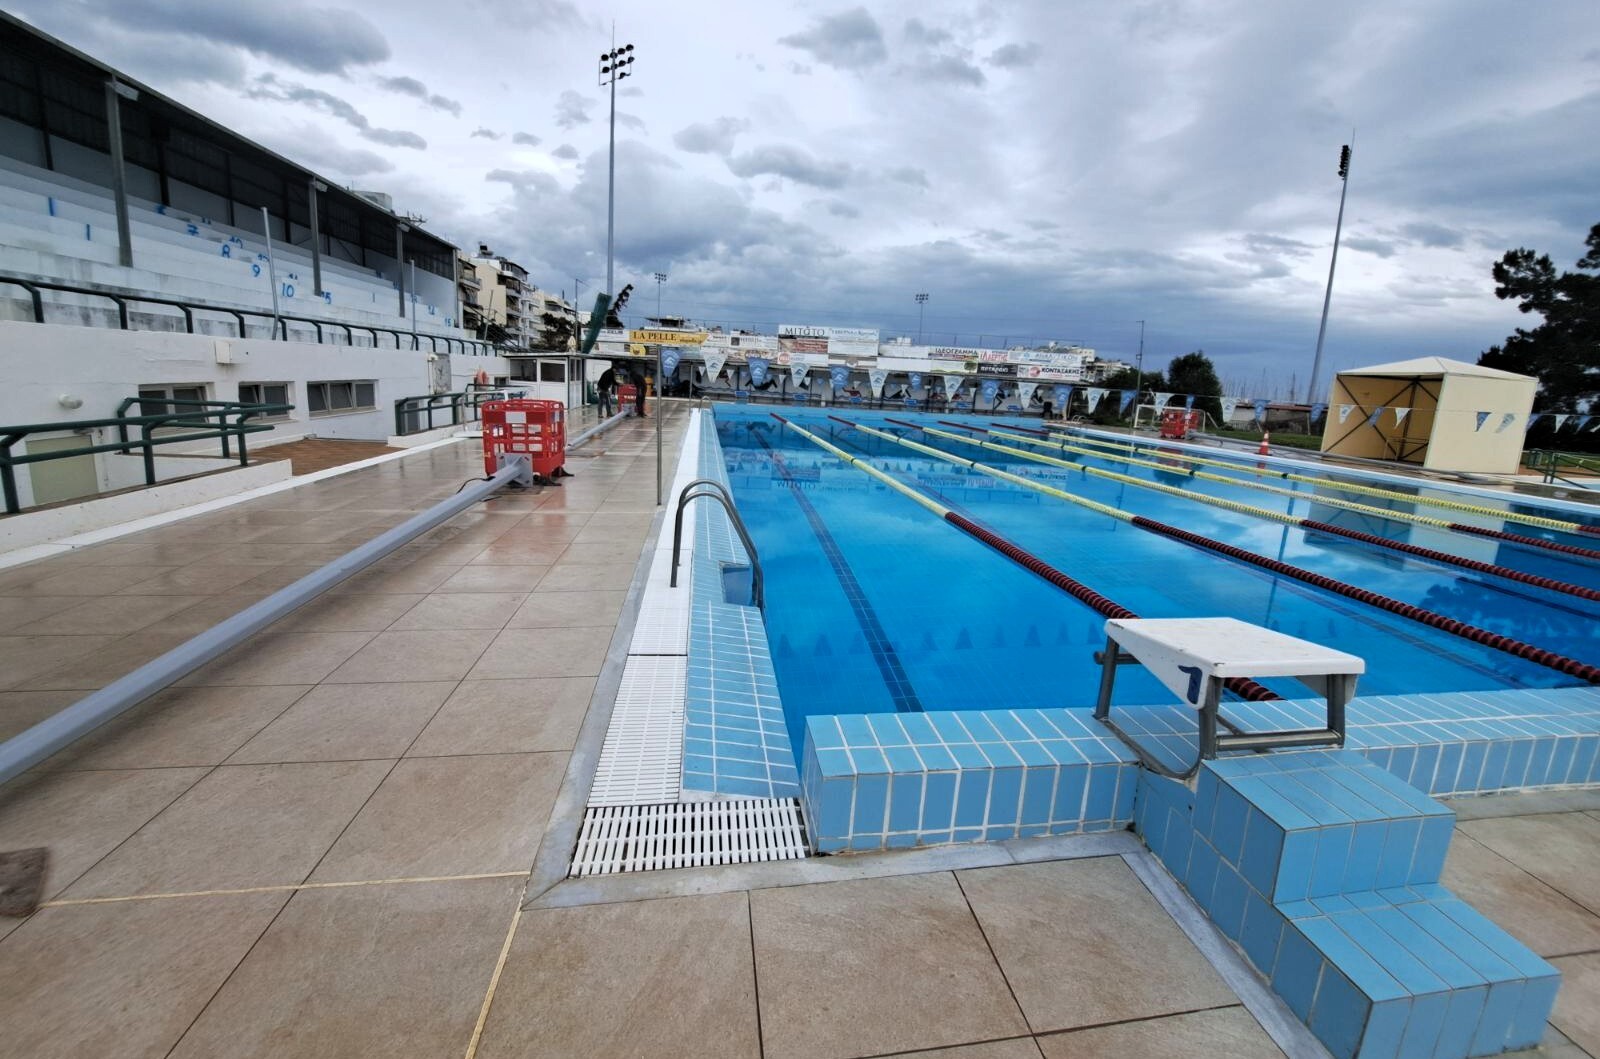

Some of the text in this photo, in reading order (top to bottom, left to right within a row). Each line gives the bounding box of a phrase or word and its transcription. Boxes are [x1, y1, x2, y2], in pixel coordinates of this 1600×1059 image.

[252, 263, 261, 277] 9
[282, 282, 295, 298] 10
[632, 331, 646, 340] LA
[648, 331, 677, 341] PELLE
